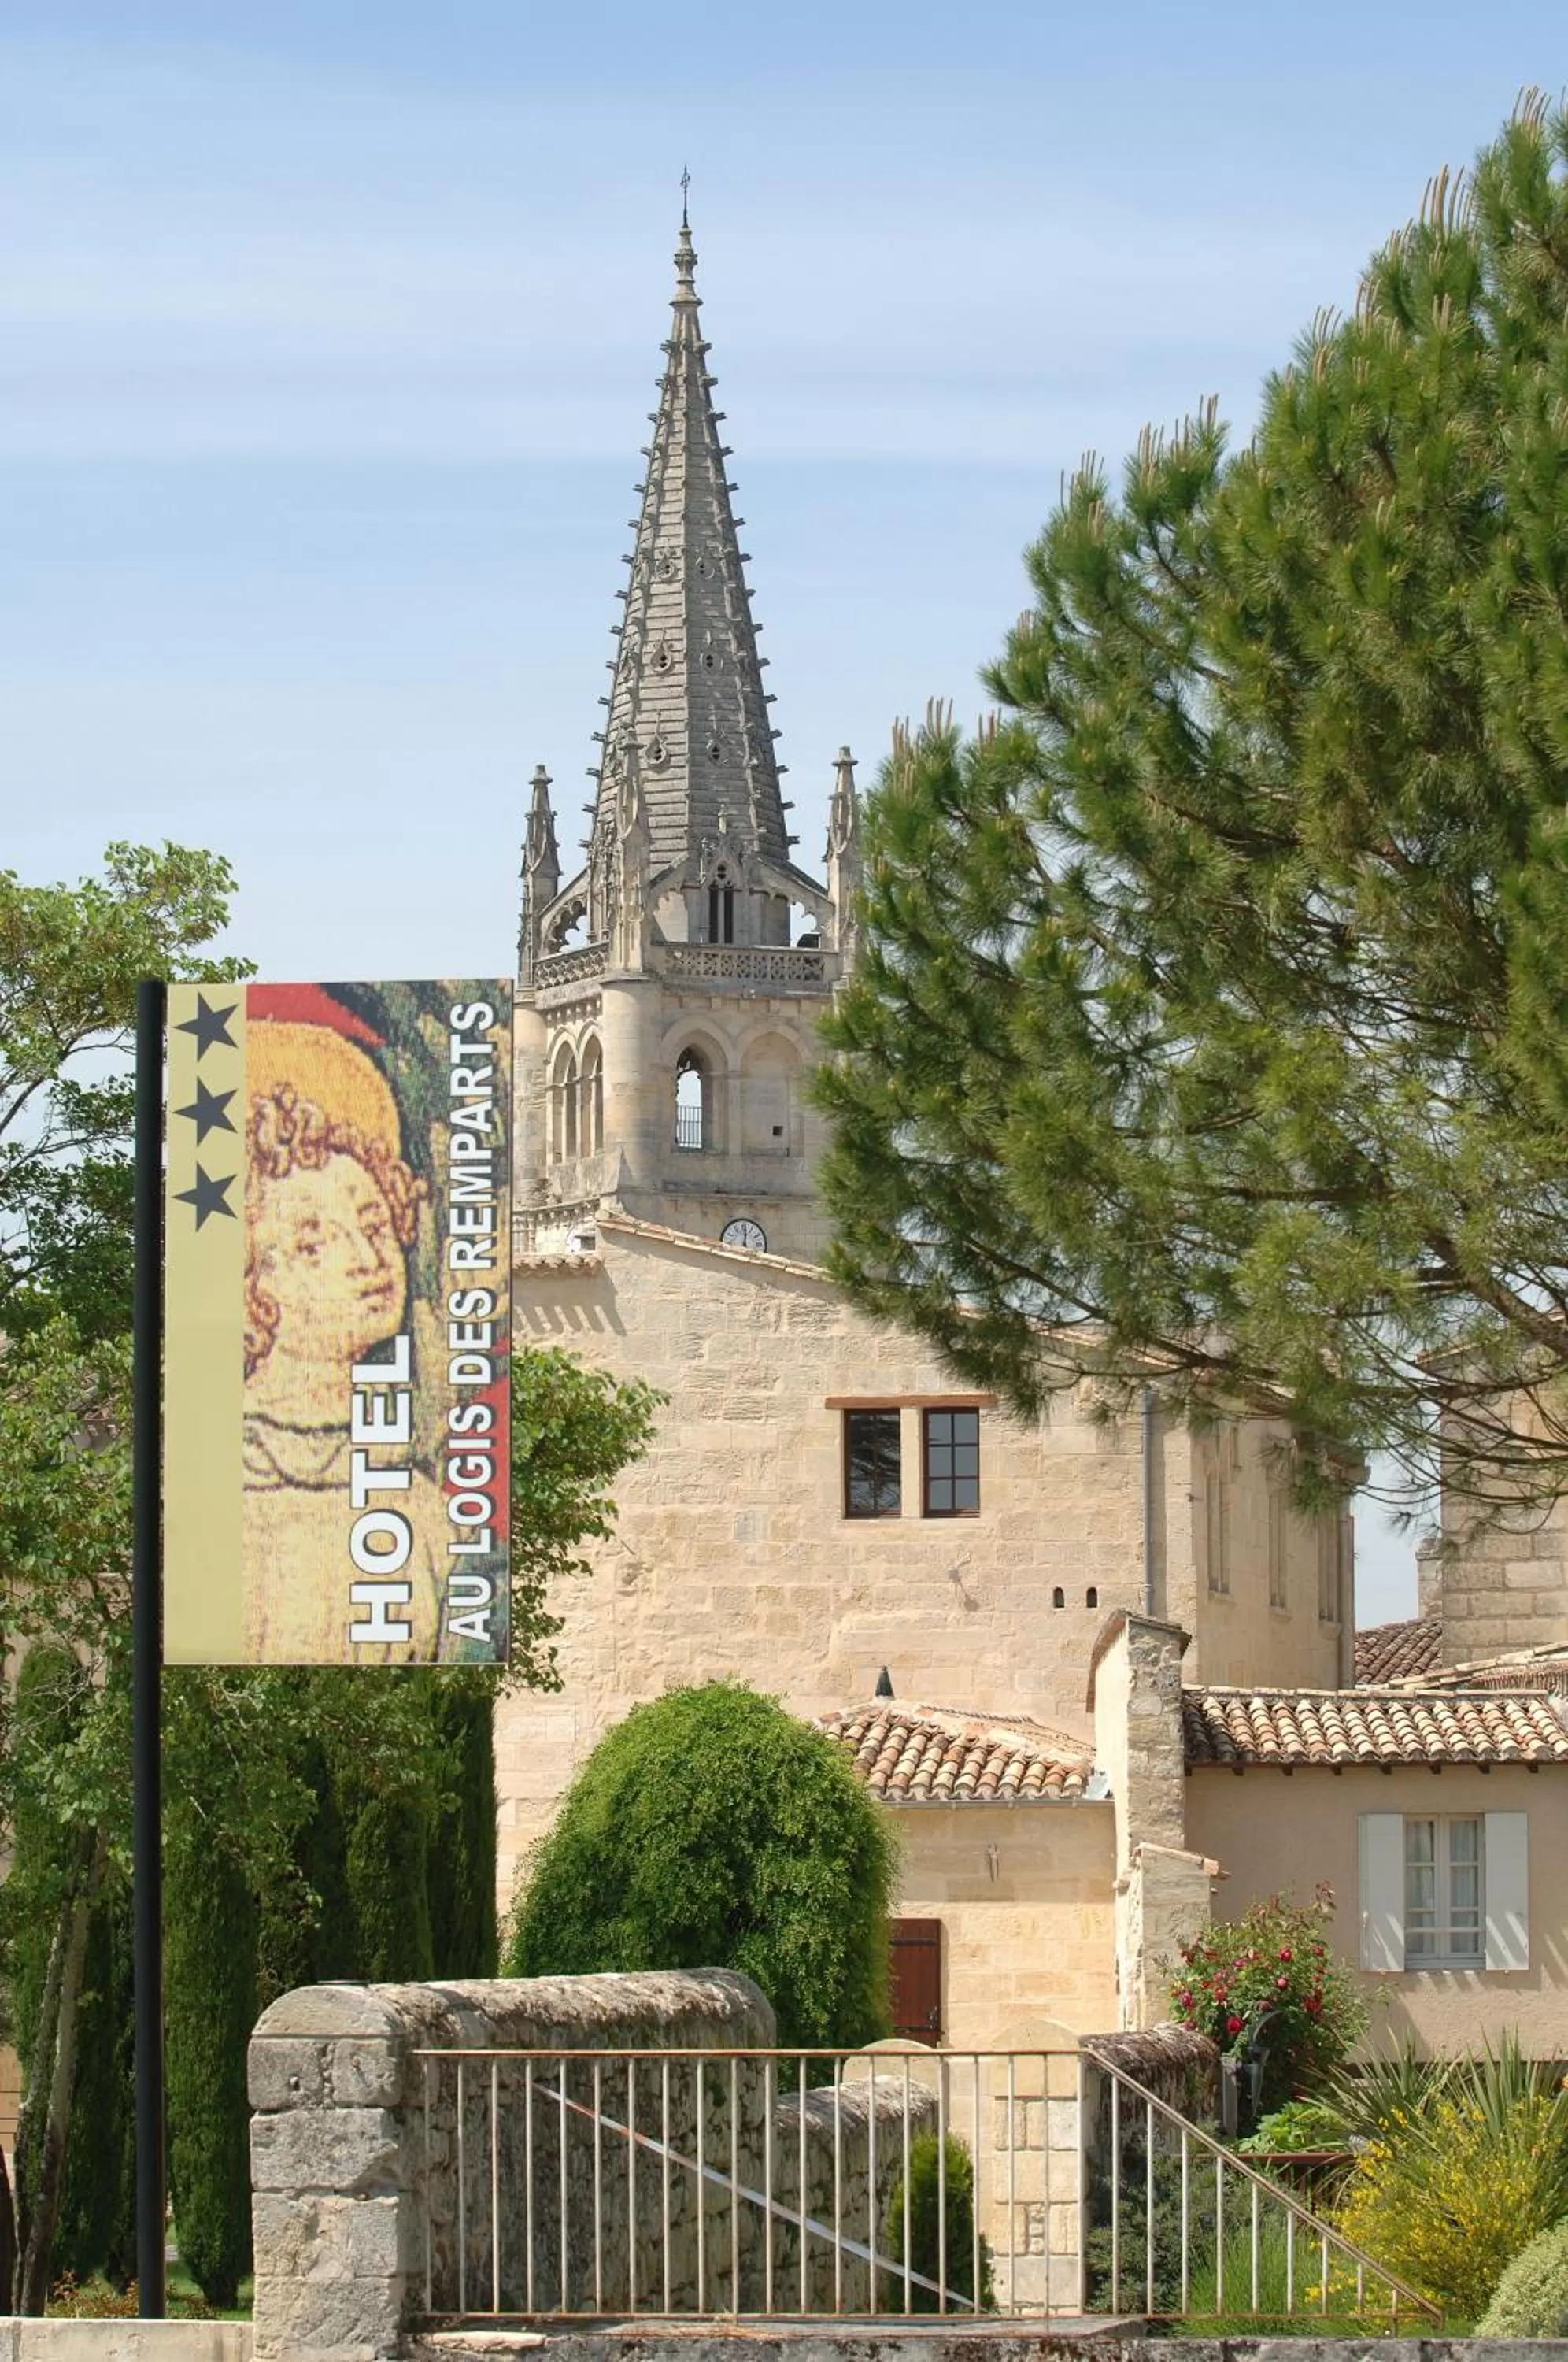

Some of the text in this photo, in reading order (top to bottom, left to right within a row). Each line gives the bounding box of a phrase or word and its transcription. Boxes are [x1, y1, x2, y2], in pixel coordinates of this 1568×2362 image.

[349, 1335, 411, 1643] HOTEL
[447, 1001, 494, 1643] AU LOGIS DES REMPARTS
